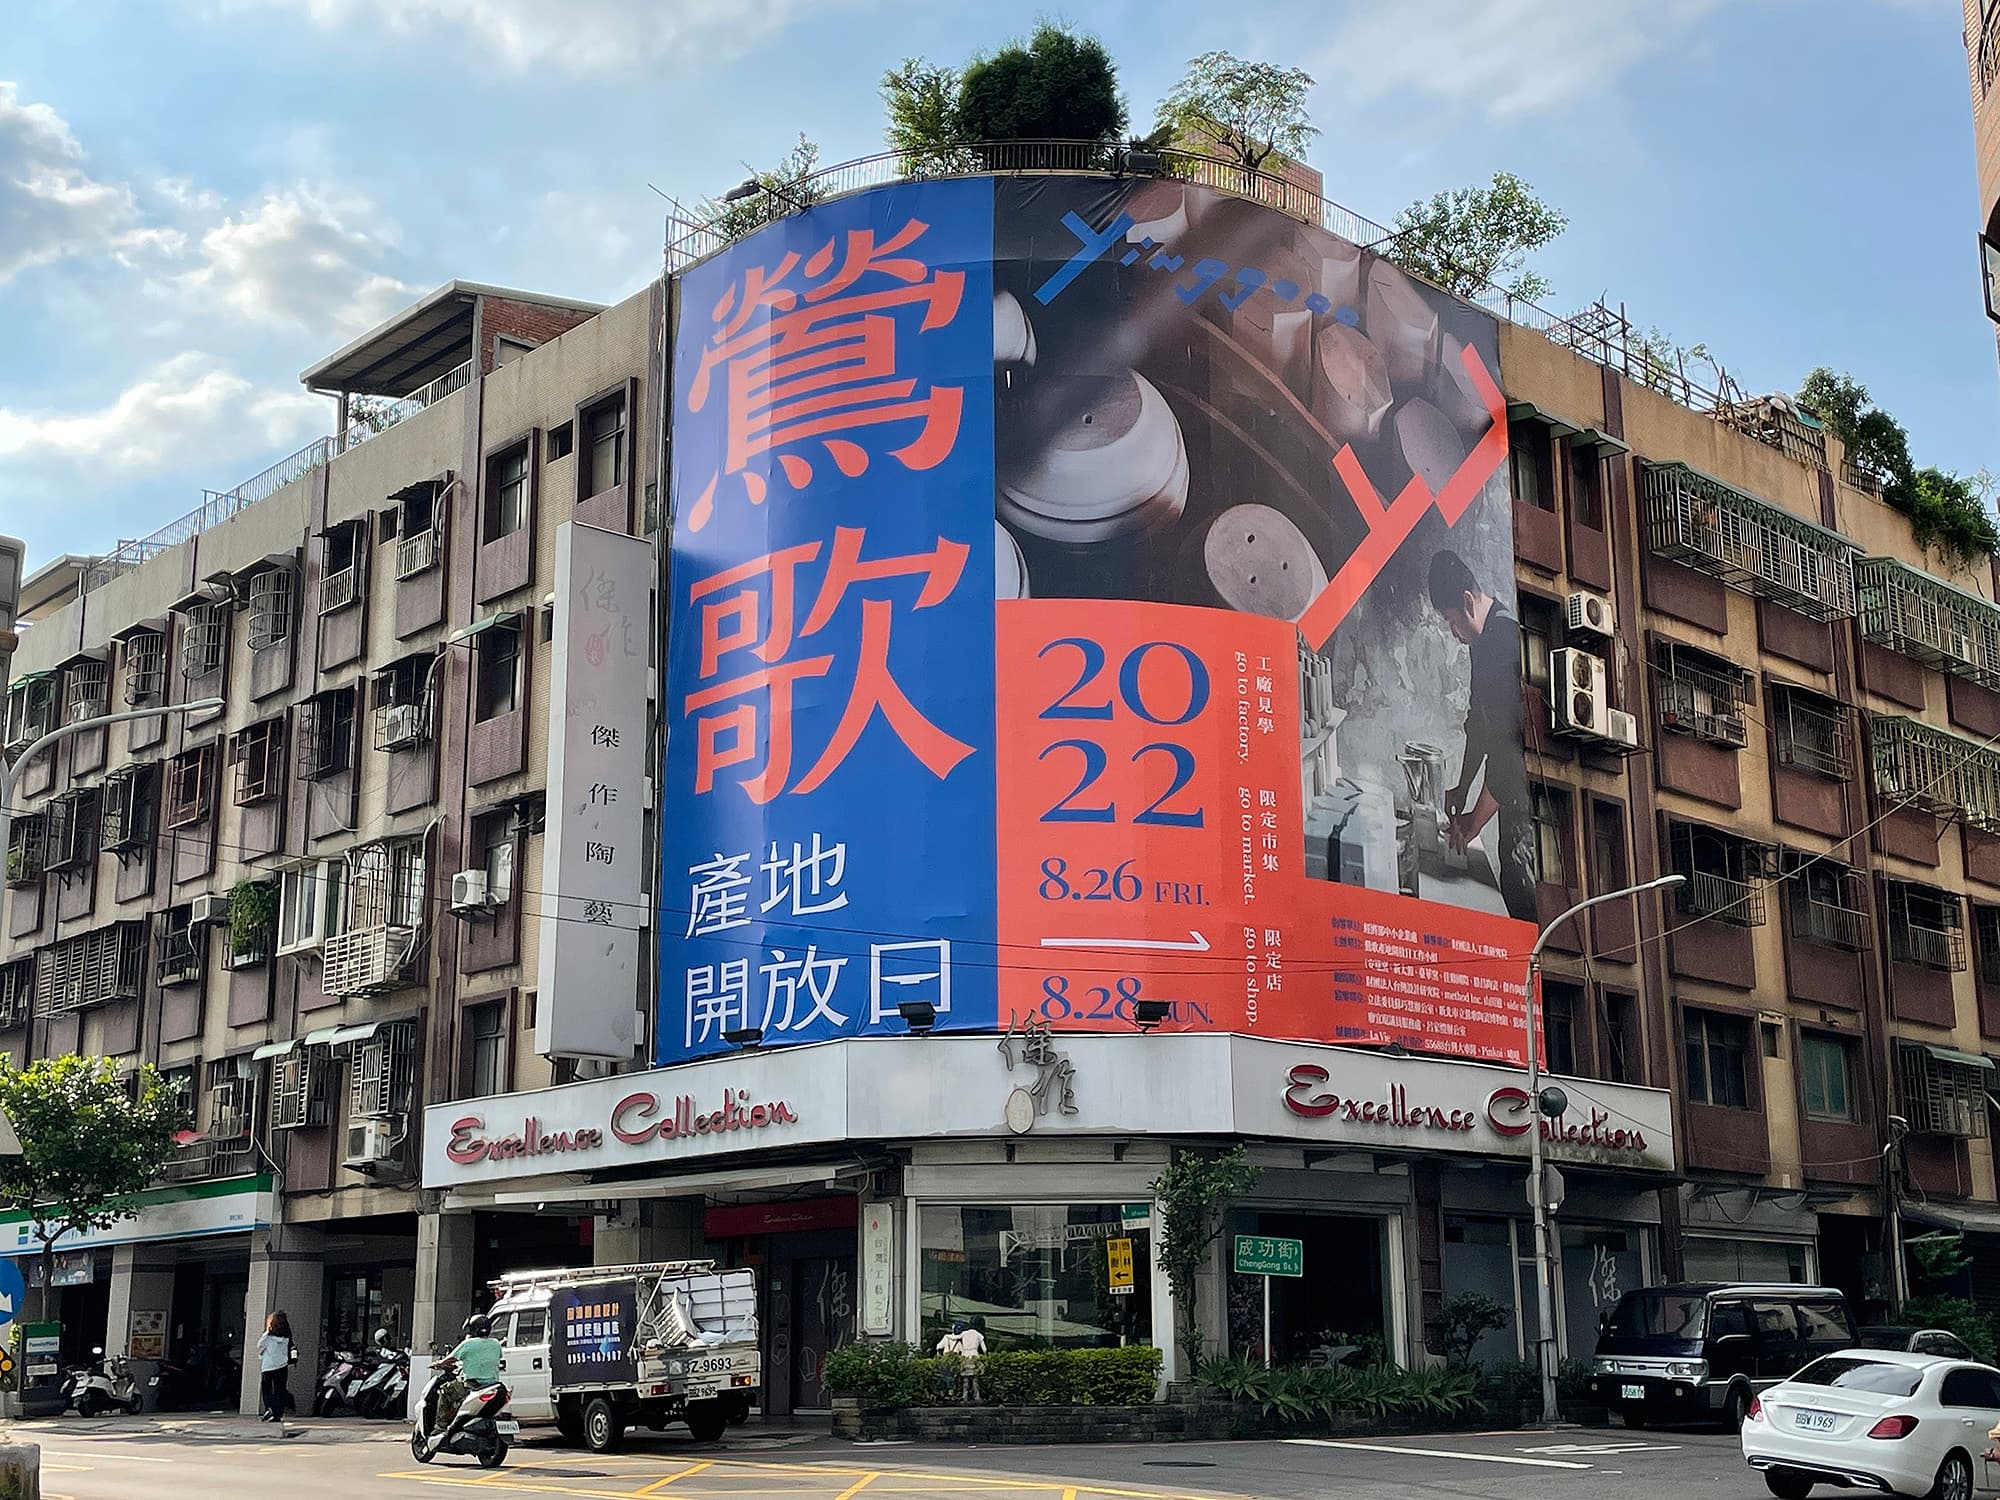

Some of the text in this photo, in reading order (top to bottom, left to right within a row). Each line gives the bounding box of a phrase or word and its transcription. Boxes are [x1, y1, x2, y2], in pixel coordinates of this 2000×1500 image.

[684, 217, 978, 804] 鶯歌
[1037, 637, 1210, 726] 20
[1234, 651, 1251, 765] go to factory.
[1256, 656, 1274, 734] 工廠見學
[583, 725, 620, 924] 傑作陶藝
[1037, 739, 1205, 828] 22
[1238, 786, 1256, 905] go to market.
[1259, 789, 1279, 872] 限定市集
[685, 832, 849, 940] 產地
[1039, 857, 1209, 906] 8.26 FRI.
[685, 939, 952, 1049] 開放日
[1040, 976, 1214, 1024] 8.28 UN.
[1243, 927, 1260, 1027] go to shop.
[1264, 929, 1282, 991] 限定店
[446, 1088, 798, 1165] Excellence Collection
[1281, 1063, 1477, 1130] Excellence
[1238, 1239, 1294, 1259] 成功街
